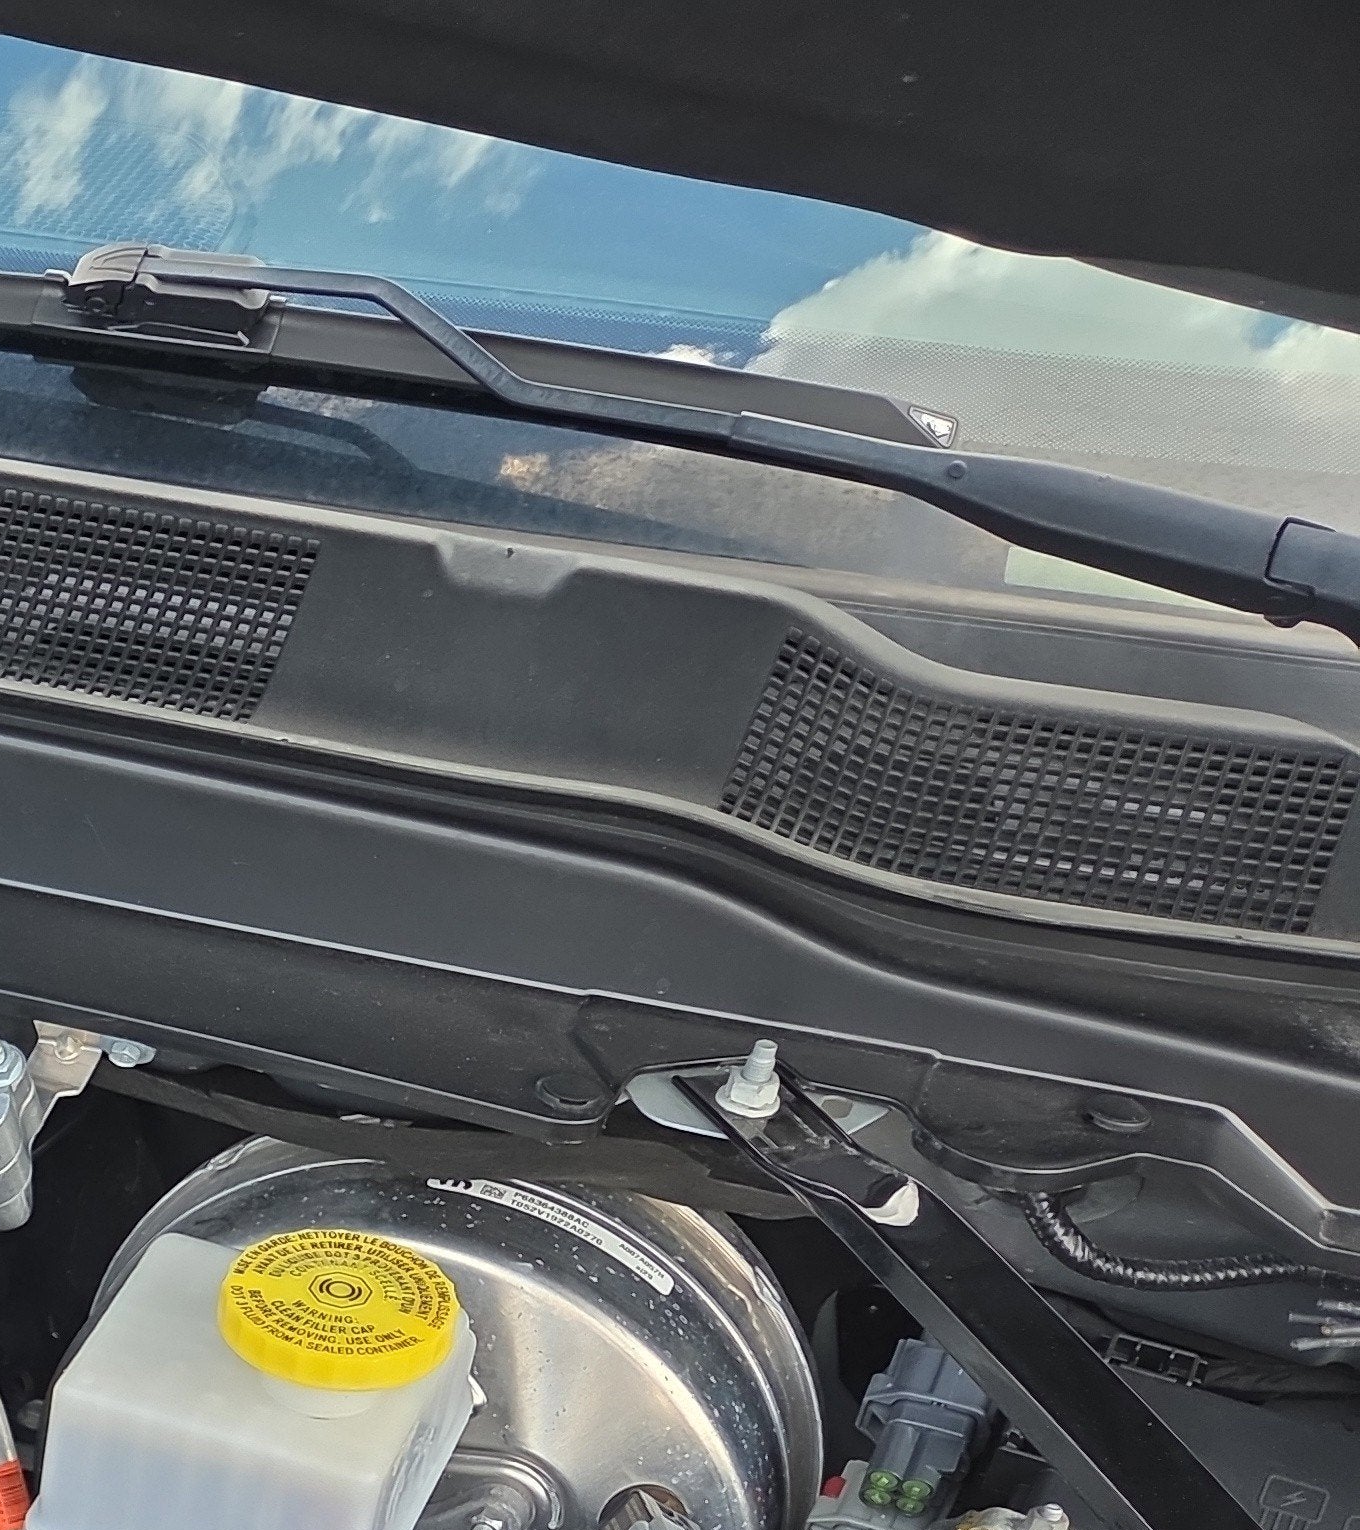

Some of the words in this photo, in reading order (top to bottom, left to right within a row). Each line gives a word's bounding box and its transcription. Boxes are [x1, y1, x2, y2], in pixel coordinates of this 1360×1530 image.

[276, 1246, 294, 1257] DE
[291, 1242, 309, 1252] LE
[366, 1247, 415, 1273] UTILISER
[297, 1230, 360, 1242] NETTOYER
[363, 1236, 379, 1246] LE
[379, 1240, 430, 1270] BOUCHON
[425, 1269, 441, 1280] DE
[324, 1250, 350, 1260] DOT
[230, 1285, 247, 1300] DOT
[240, 1305, 266, 1327] FLUID
[261, 1324, 294, 1344] FROM
[294, 1338, 305, 1347] A
[305, 1341, 355, 1355] SEALED
[247, 1289, 277, 1319] BEFORE
[273, 1317, 342, 1345] REMOVING.
[345, 1335, 373, 1346] USE
[374, 1328, 407, 1344] ONLY
[270, 1300, 303, 1322] CLEAN
[302, 1318, 347, 1335] FILLER
[350, 1323, 376, 1336] CAP
